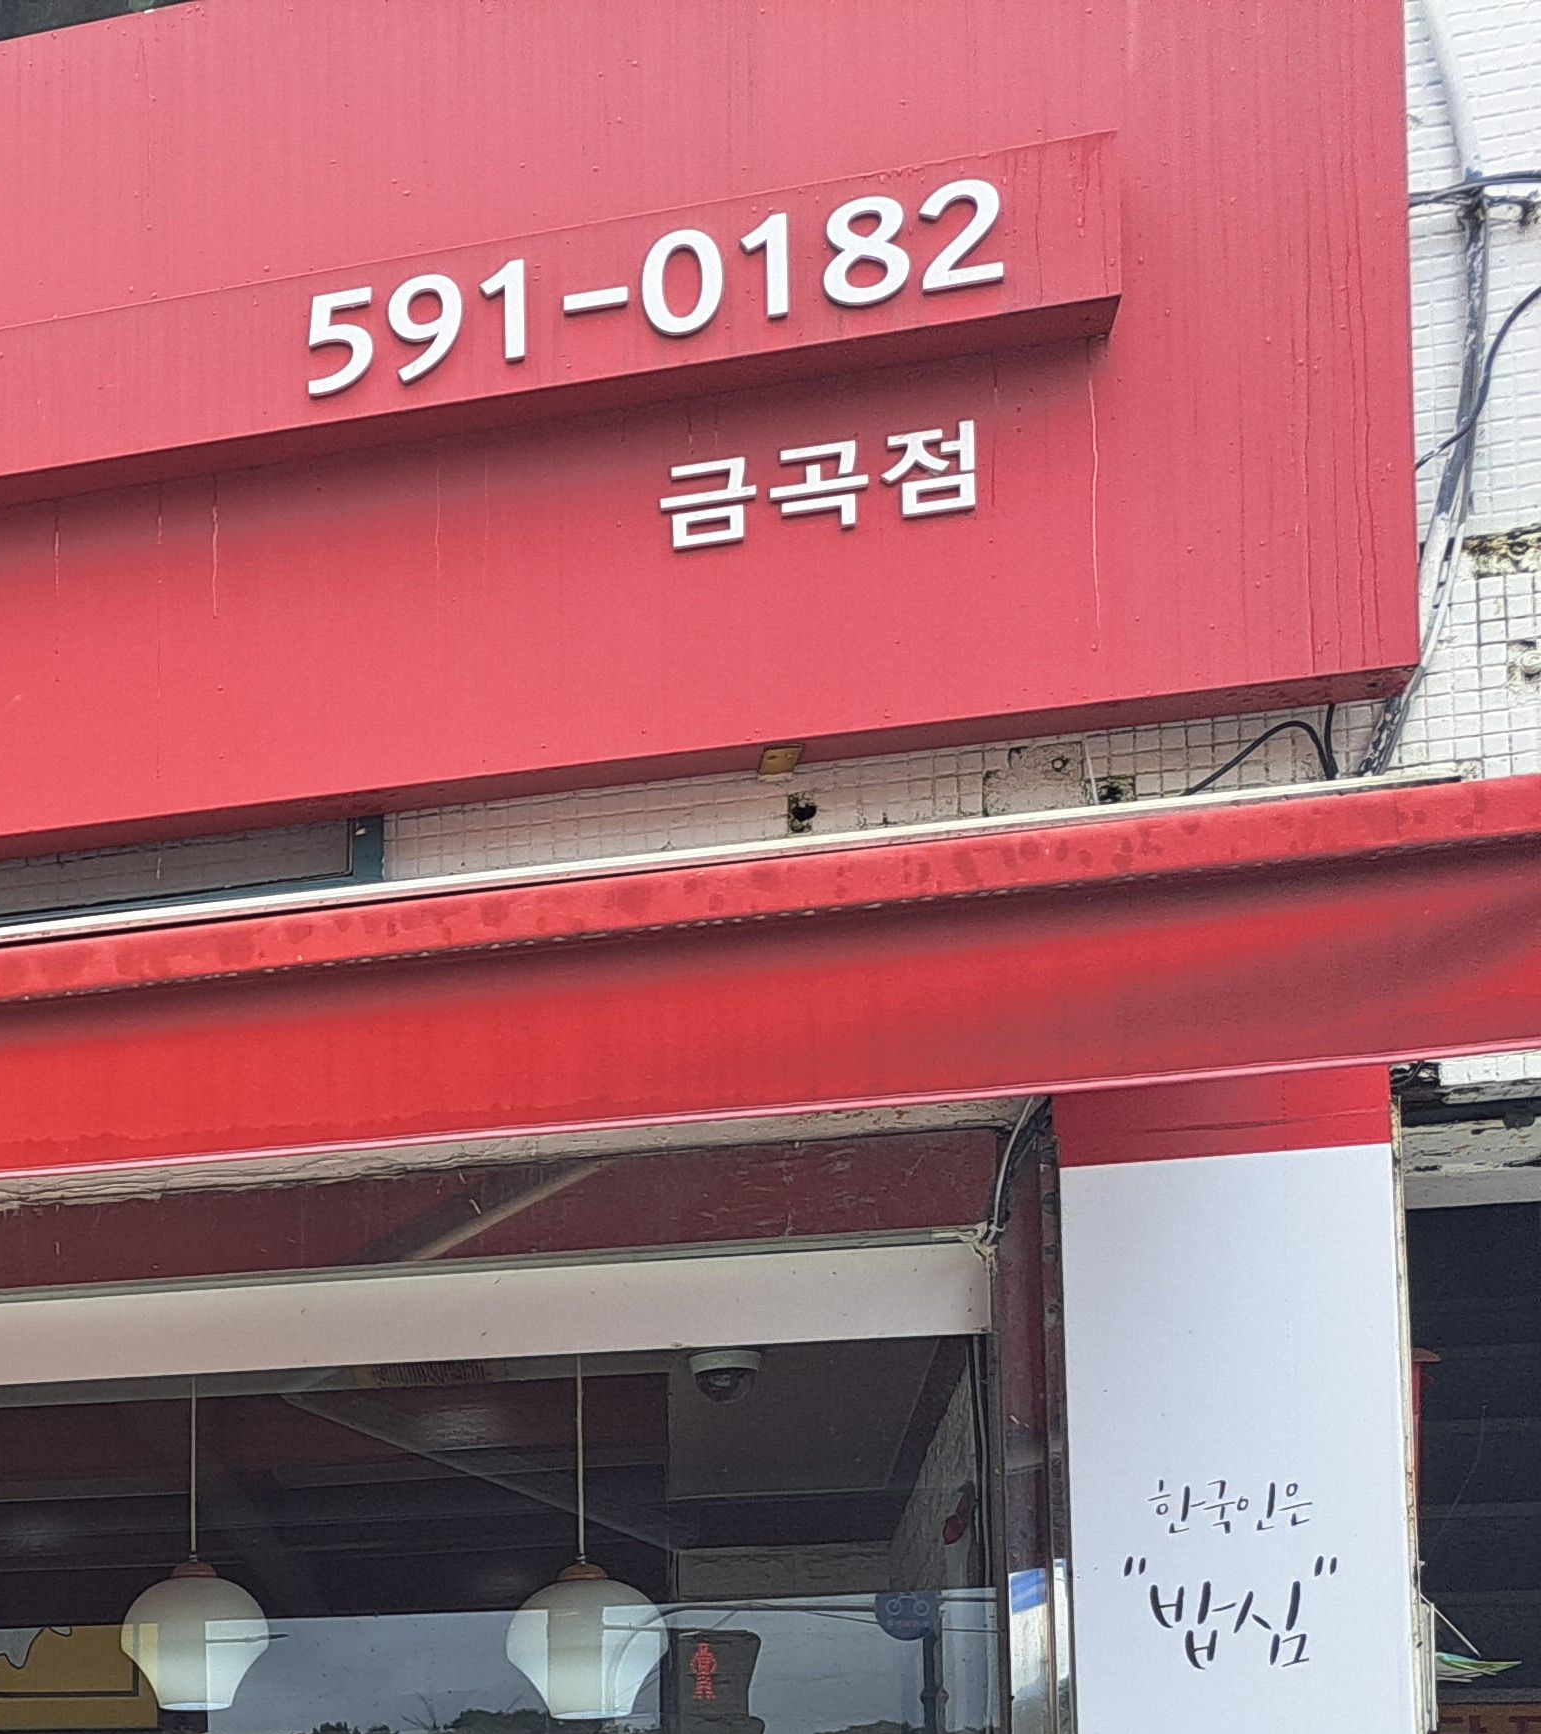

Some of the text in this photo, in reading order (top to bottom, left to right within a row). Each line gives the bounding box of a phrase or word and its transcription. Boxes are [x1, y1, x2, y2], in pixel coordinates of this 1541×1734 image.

[307, 177, 1005, 398] 591-0182
[659, 419, 979, 551] 금곡점
[1147, 1478, 1313, 1534] 한국인은
